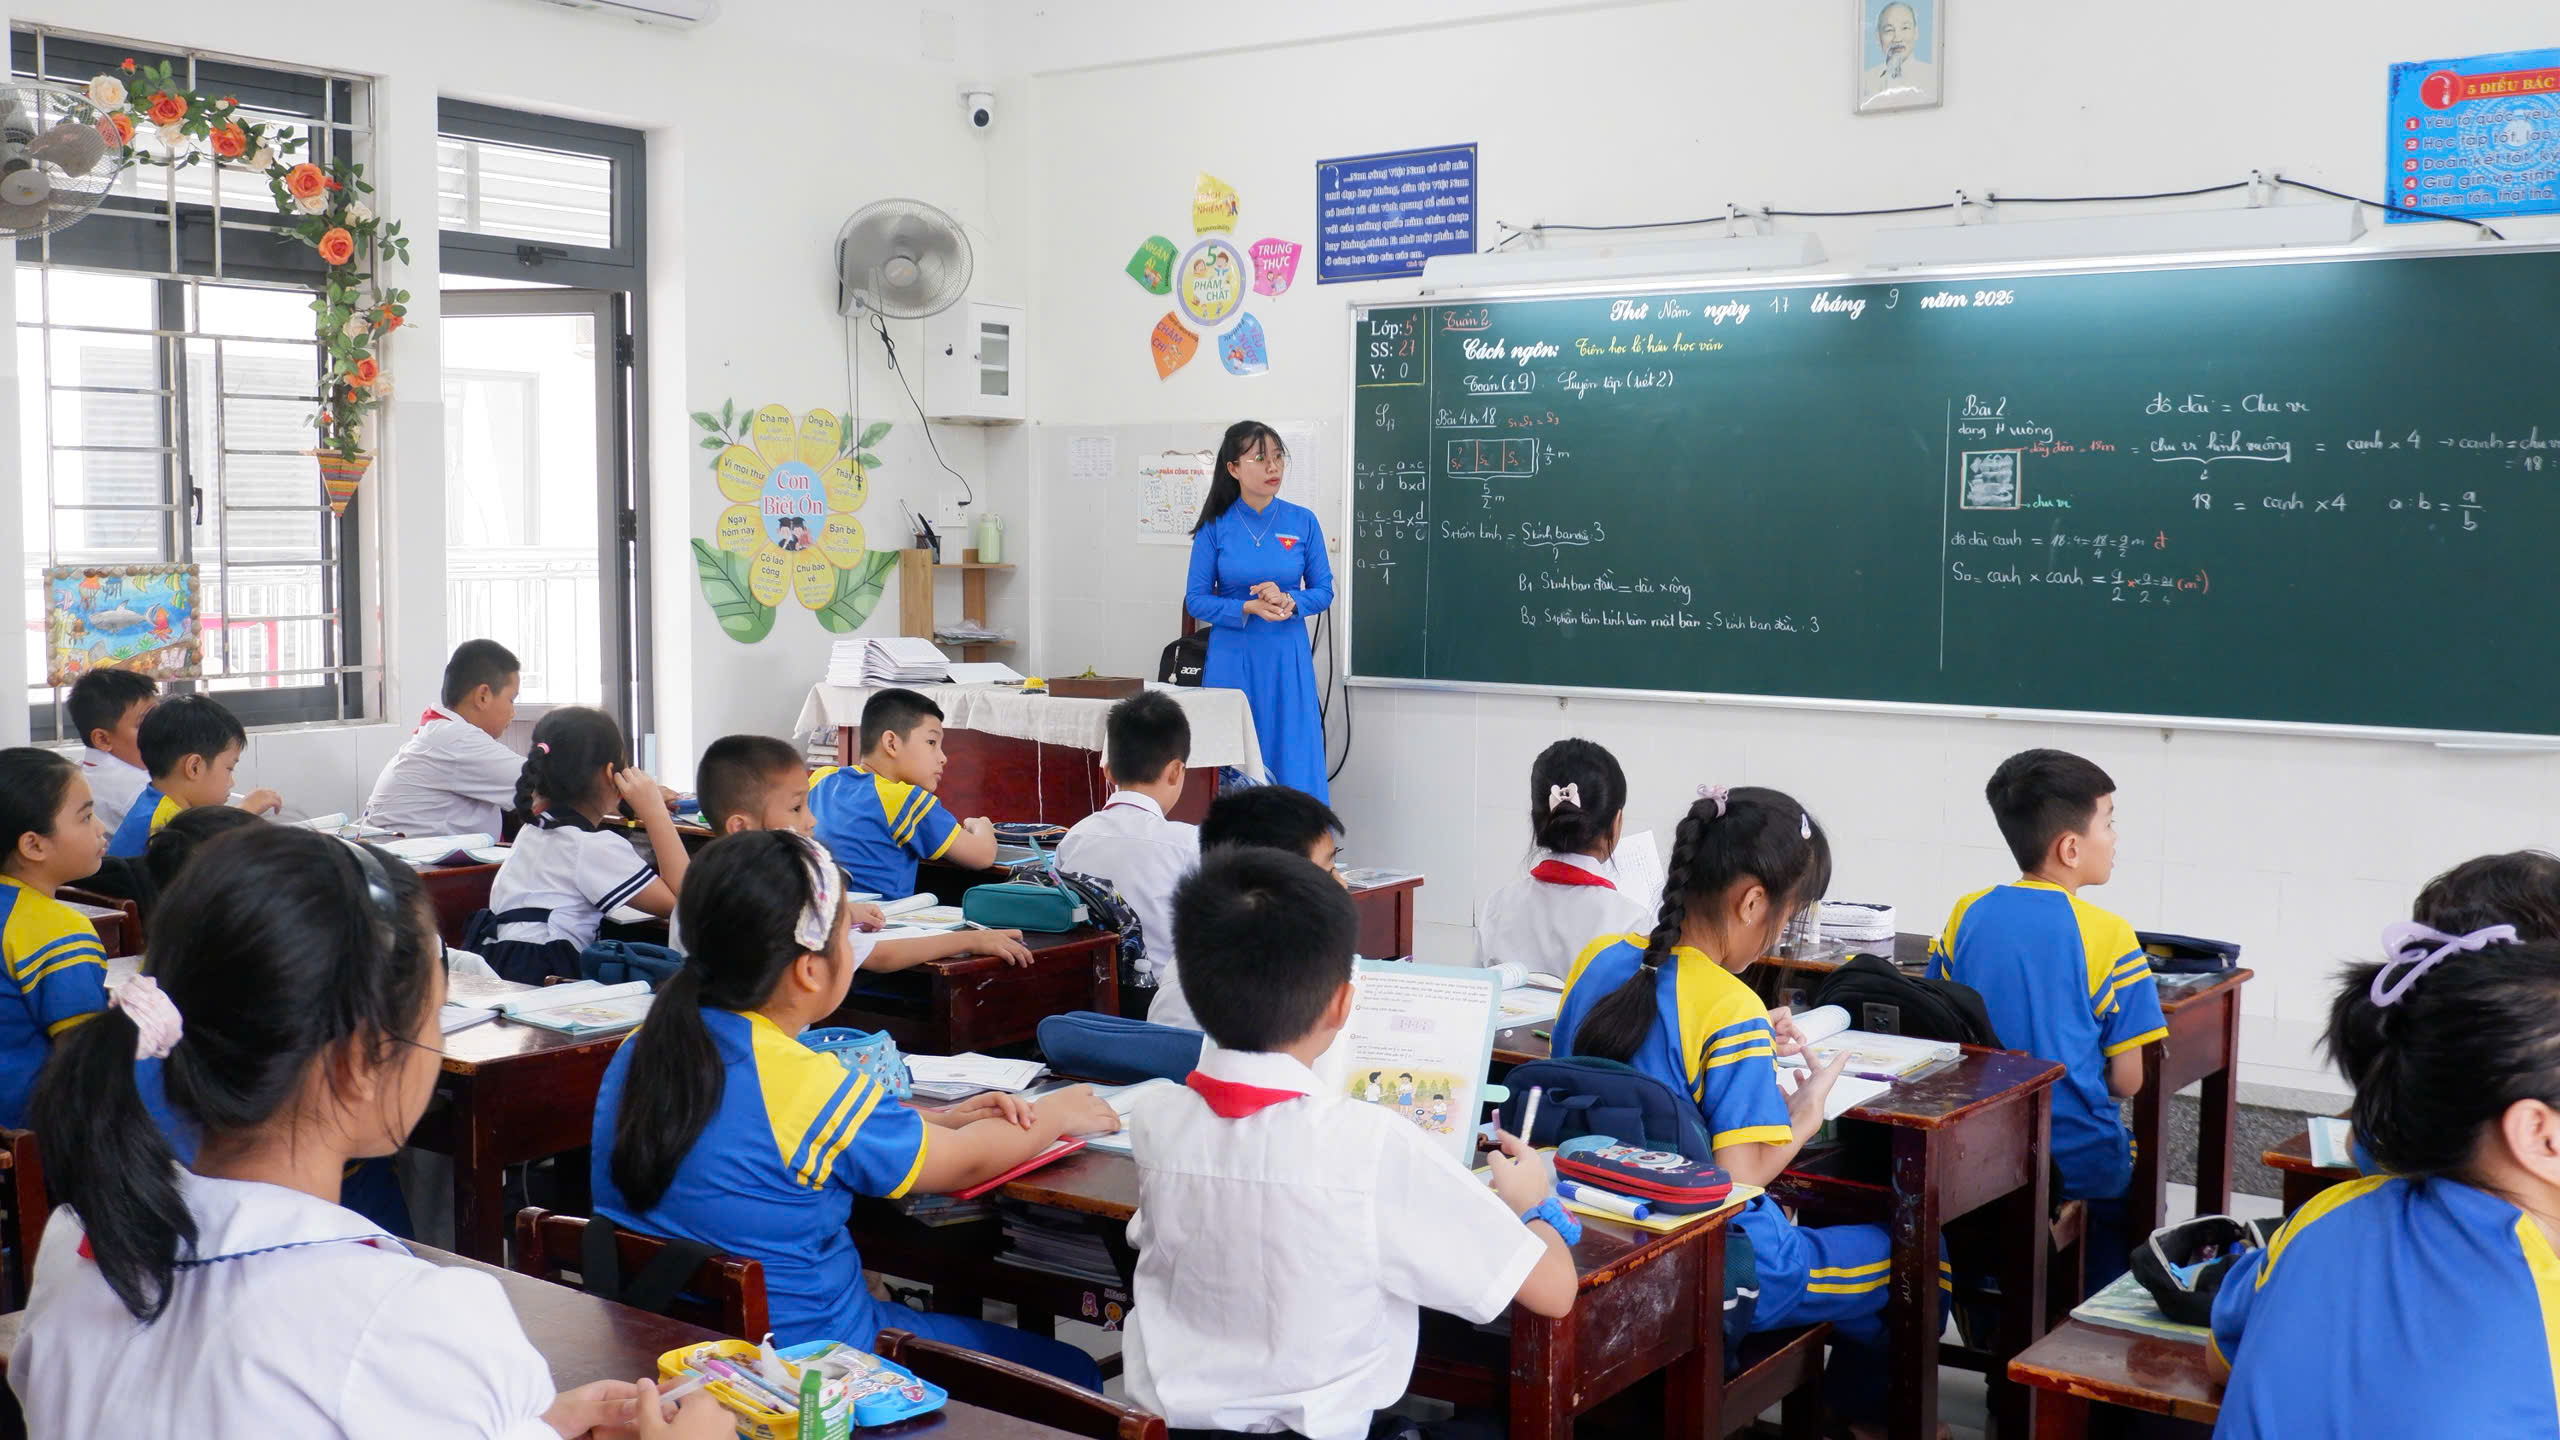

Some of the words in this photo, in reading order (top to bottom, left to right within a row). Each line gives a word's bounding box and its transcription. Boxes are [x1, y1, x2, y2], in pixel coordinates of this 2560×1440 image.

[2467, 85, 2476, 95] 5
[1206, 245, 1218, 266] 5
[1258, 243, 1292, 256] TRUNG
[1610, 299, 1649, 321] Thứ
[1658, 299, 1692, 319] Năm
[1703, 298, 1751, 325] ngày
[1769, 296, 1790, 314] 17
[1810, 291, 1867, 320] tháng
[1885, 288, 1899, 309] 9
[1920, 290, 1968, 309] năm
[1972, 289, 2014, 307] 2026
[1480, 308, 1491, 326] 2
[1371, 320, 1402, 338] Lớp:
[1370, 342, 1393, 358] SS:
[1398, 339, 1416, 357] 27
[1463, 337, 1506, 360] Cách
[1510, 340, 1560, 366] ngôn:
[1370, 364, 1385, 380] V:
[1400, 362, 1408, 378] 0
[1463, 374, 1500, 391] Toán
[1962, 394, 1992, 416] Bài
[1996, 396, 2006, 416] 2
[760, 413, 776, 423] Cha
[1435, 408, 1457, 426] Bài
[1459, 407, 1468, 426] 4
[1481, 407, 1497, 425] 18
[2009, 420, 2054, 443] vuông
[2407, 429, 2421, 449] 4
[776, 471, 810, 490] Con
[763, 494, 795, 515] Biết
[2192, 493, 2211, 510] 18
[1180, 666, 1202, 675] acer
